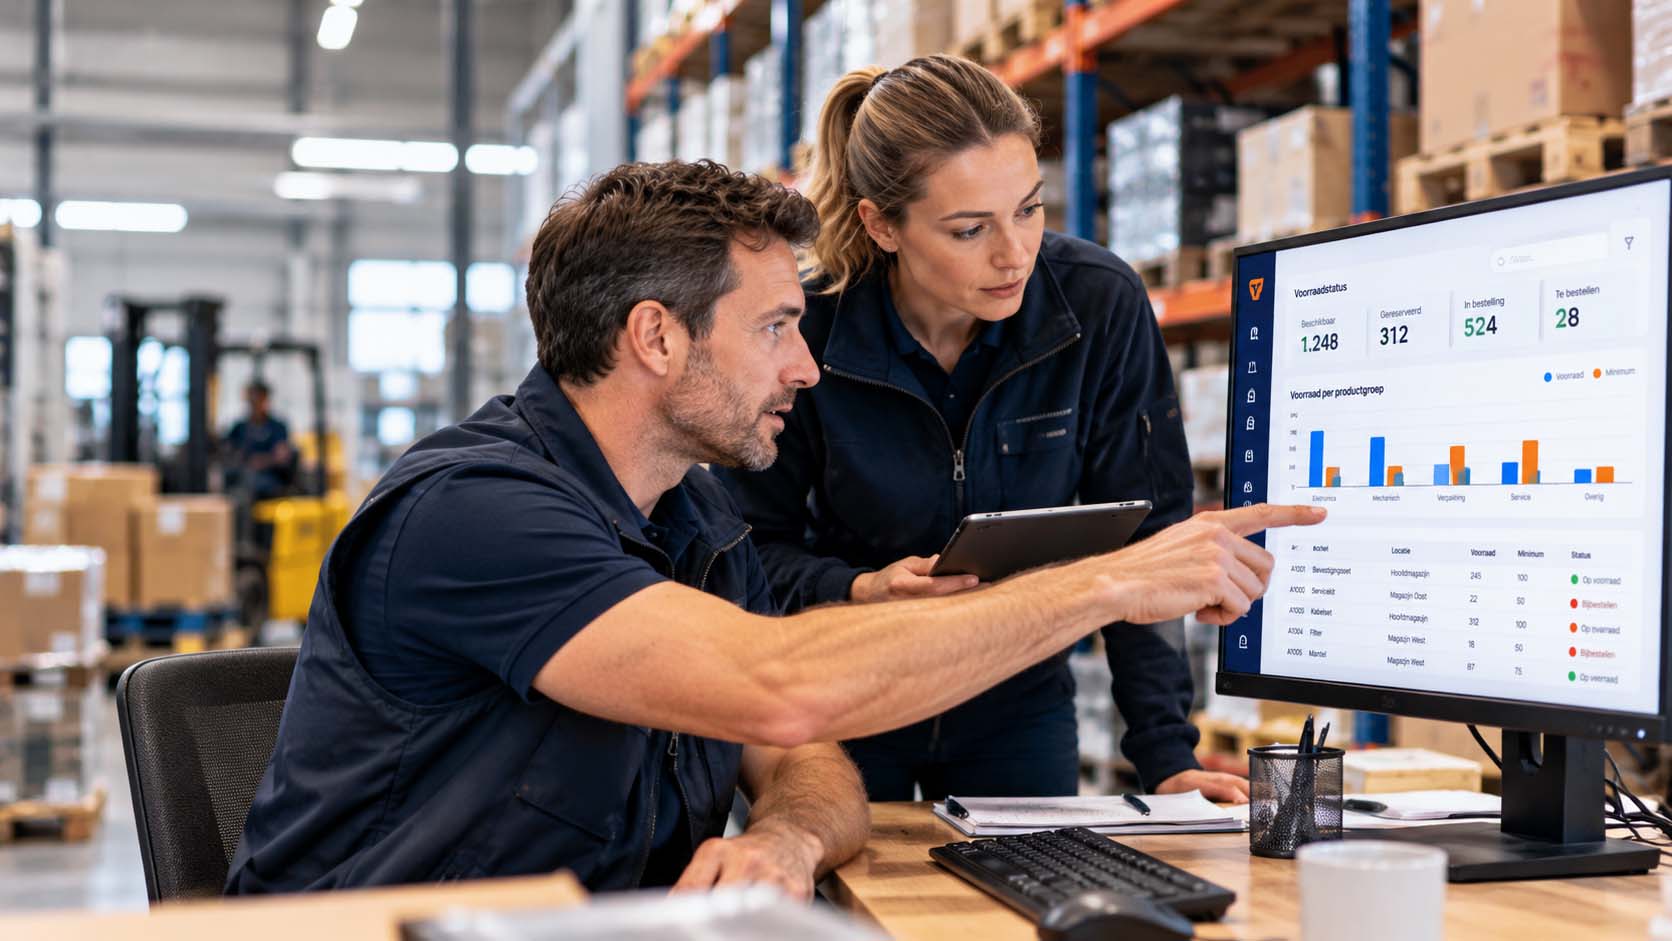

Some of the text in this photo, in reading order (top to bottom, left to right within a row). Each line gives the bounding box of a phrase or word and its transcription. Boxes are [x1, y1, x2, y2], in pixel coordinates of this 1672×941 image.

[1294, 283, 1348, 298] Voorraadstatus
[1555, 285, 1600, 299] Te bestellen
[1464, 296, 1505, 309] In bestelling
[1380, 306, 1422, 319] Gereserveerd
[1555, 307, 1580, 329] 28
[1464, 315, 1498, 337] 524
[1380, 325, 1409, 346] 312
[1301, 333, 1339, 352] 1.248
[1556, 371, 1585, 381] Voorraad
[1605, 368, 1636, 377] Minimum
[1290, 384, 1385, 400] Voorraad per productgroep
[1391, 546, 1411, 555] Locatie
[1470, 549, 1496, 557] Voorraad
[1517, 550, 1545, 558] Minimum
[1571, 551, 1592, 560] Status
